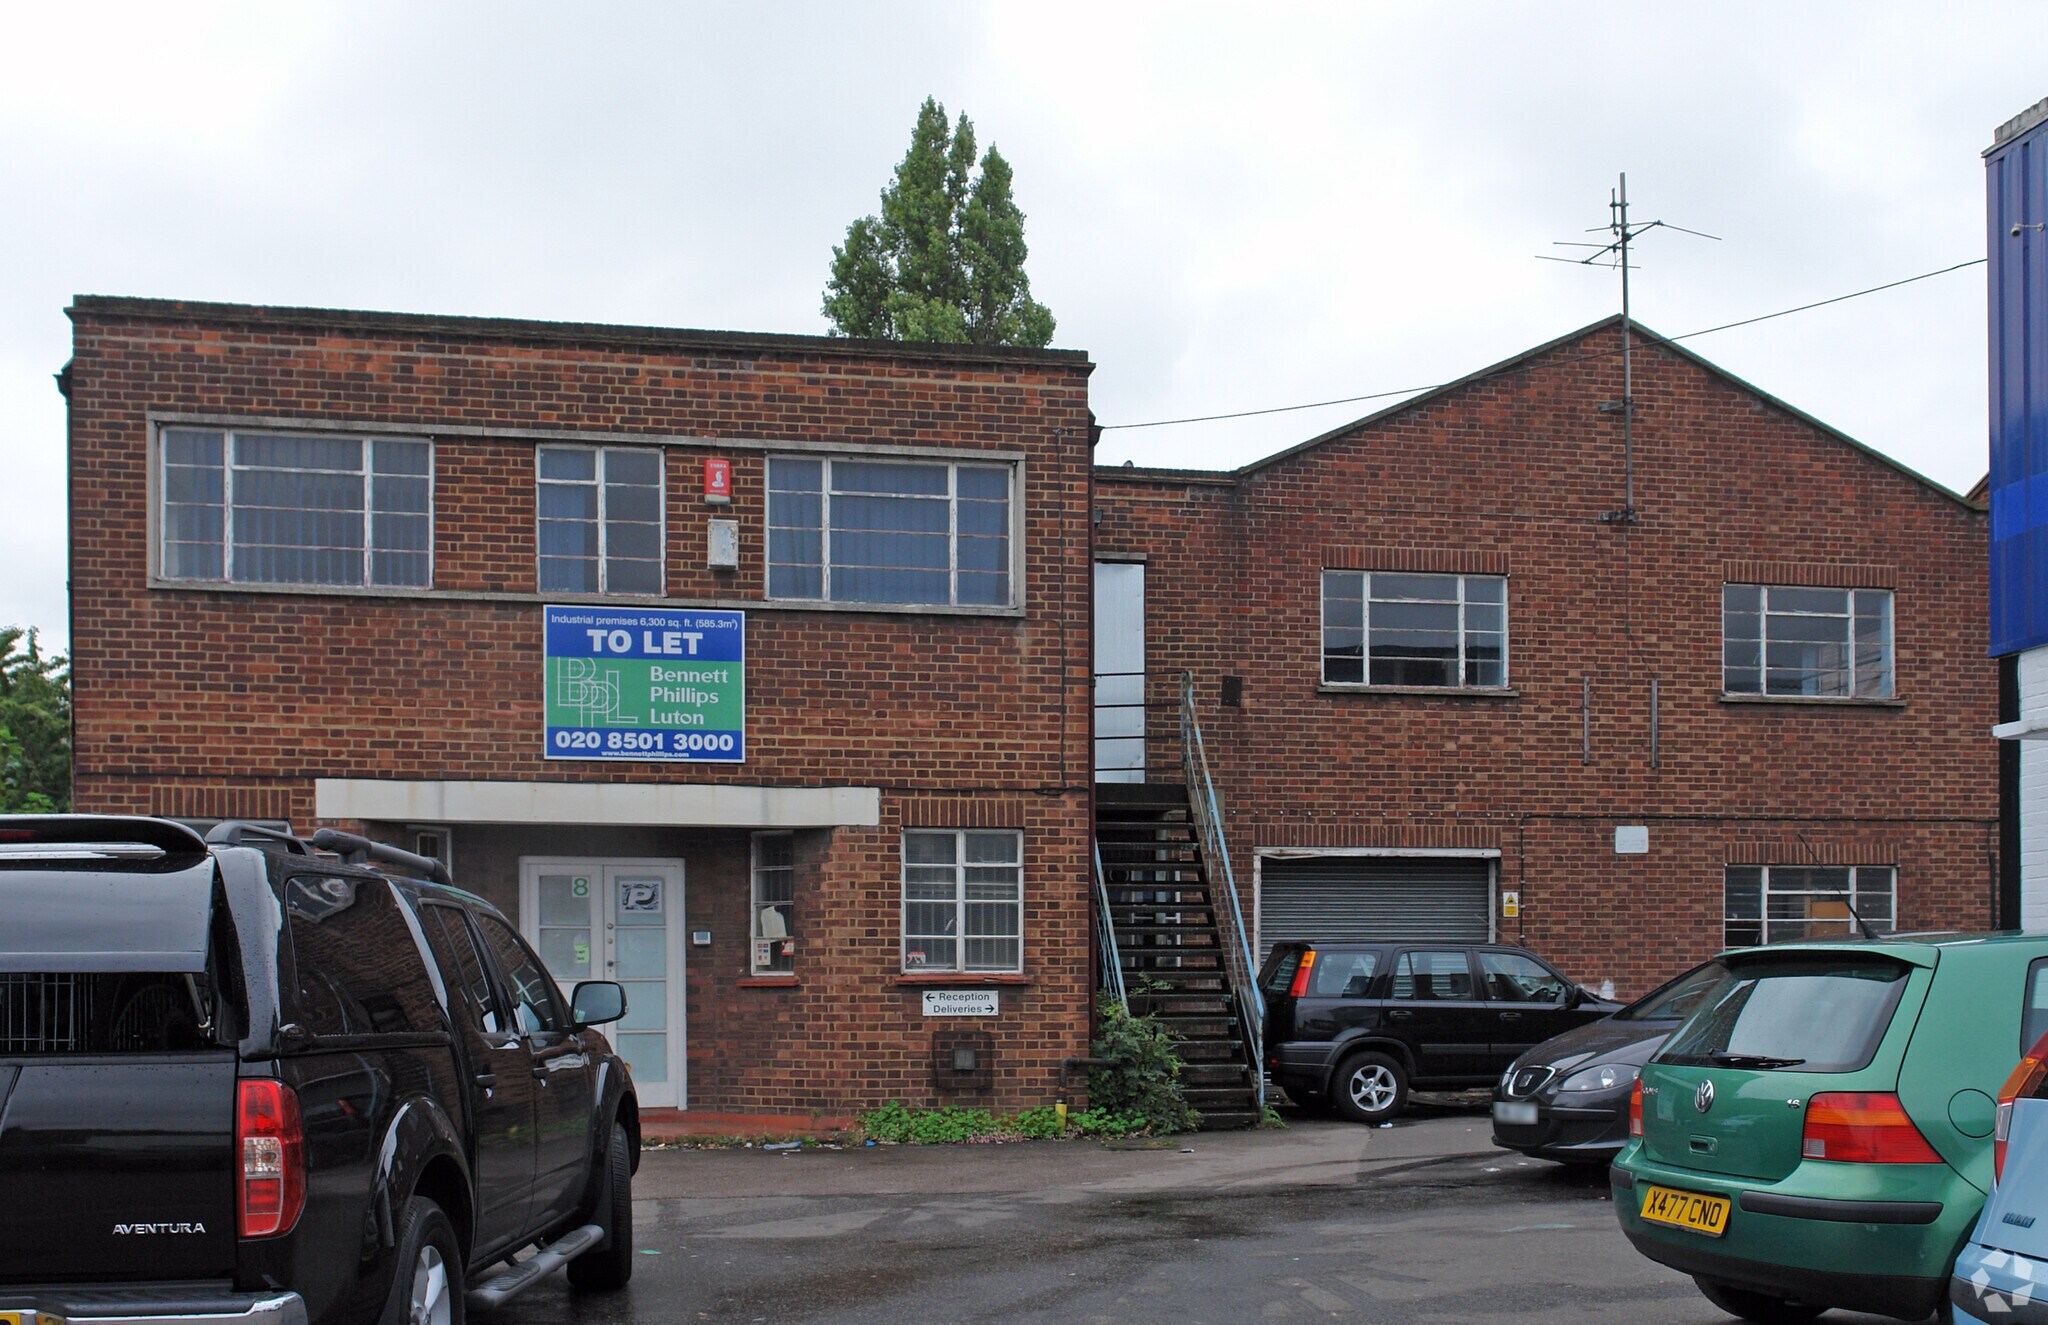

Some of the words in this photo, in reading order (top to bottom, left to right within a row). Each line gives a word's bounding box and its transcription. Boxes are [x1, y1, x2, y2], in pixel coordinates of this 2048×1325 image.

[551, 614, 593, 625] Industrial
[596, 616, 638, 628] premises
[640, 617, 666, 628] 6,300
[668, 620, 681, 629] sq.
[684, 619, 693, 628] ft.
[586, 629, 632, 653] TO
[643, 631, 703, 655] LET
[650, 666, 729, 684] Bennett
[650, 687, 719, 707] Phillips
[650, 708, 705, 725] Luton
[555, 730, 602, 749] 020
[607, 731, 664, 750] 8501
[673, 733, 734, 751] 3000
[601, 749, 689, 758] www.bennettphillips.com
[573, 877, 589, 896] 8
[939, 992, 990, 1002] Reception
[933, 1004, 983, 1014] Deliveries
[1647, 1190, 1689, 1220] X477
[1688, 1198, 1723, 1228] CNO
[112, 1222, 206, 1236] AVENTURA
